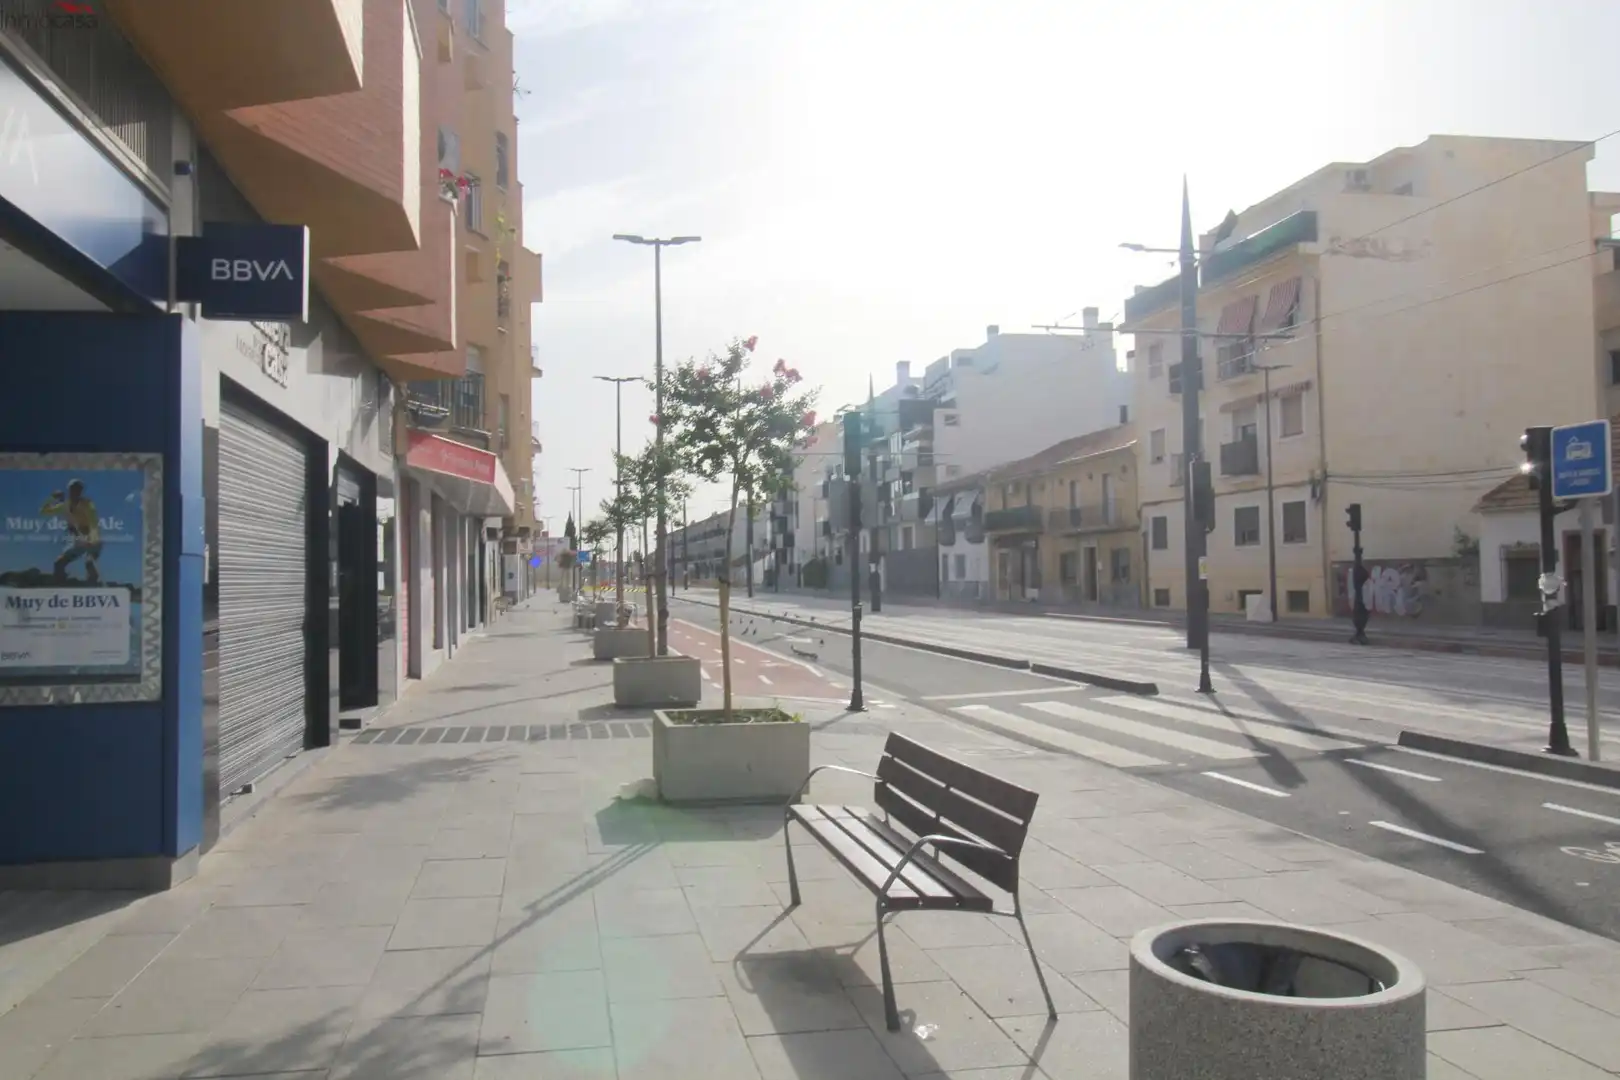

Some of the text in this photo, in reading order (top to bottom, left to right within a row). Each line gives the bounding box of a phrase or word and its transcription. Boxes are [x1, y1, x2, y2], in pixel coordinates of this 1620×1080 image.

[211, 258, 294, 281] BBVA
[6, 516, 46, 533] Muy
[47, 514, 68, 530] de
[5, 593, 121, 612] Muy de BBVA
